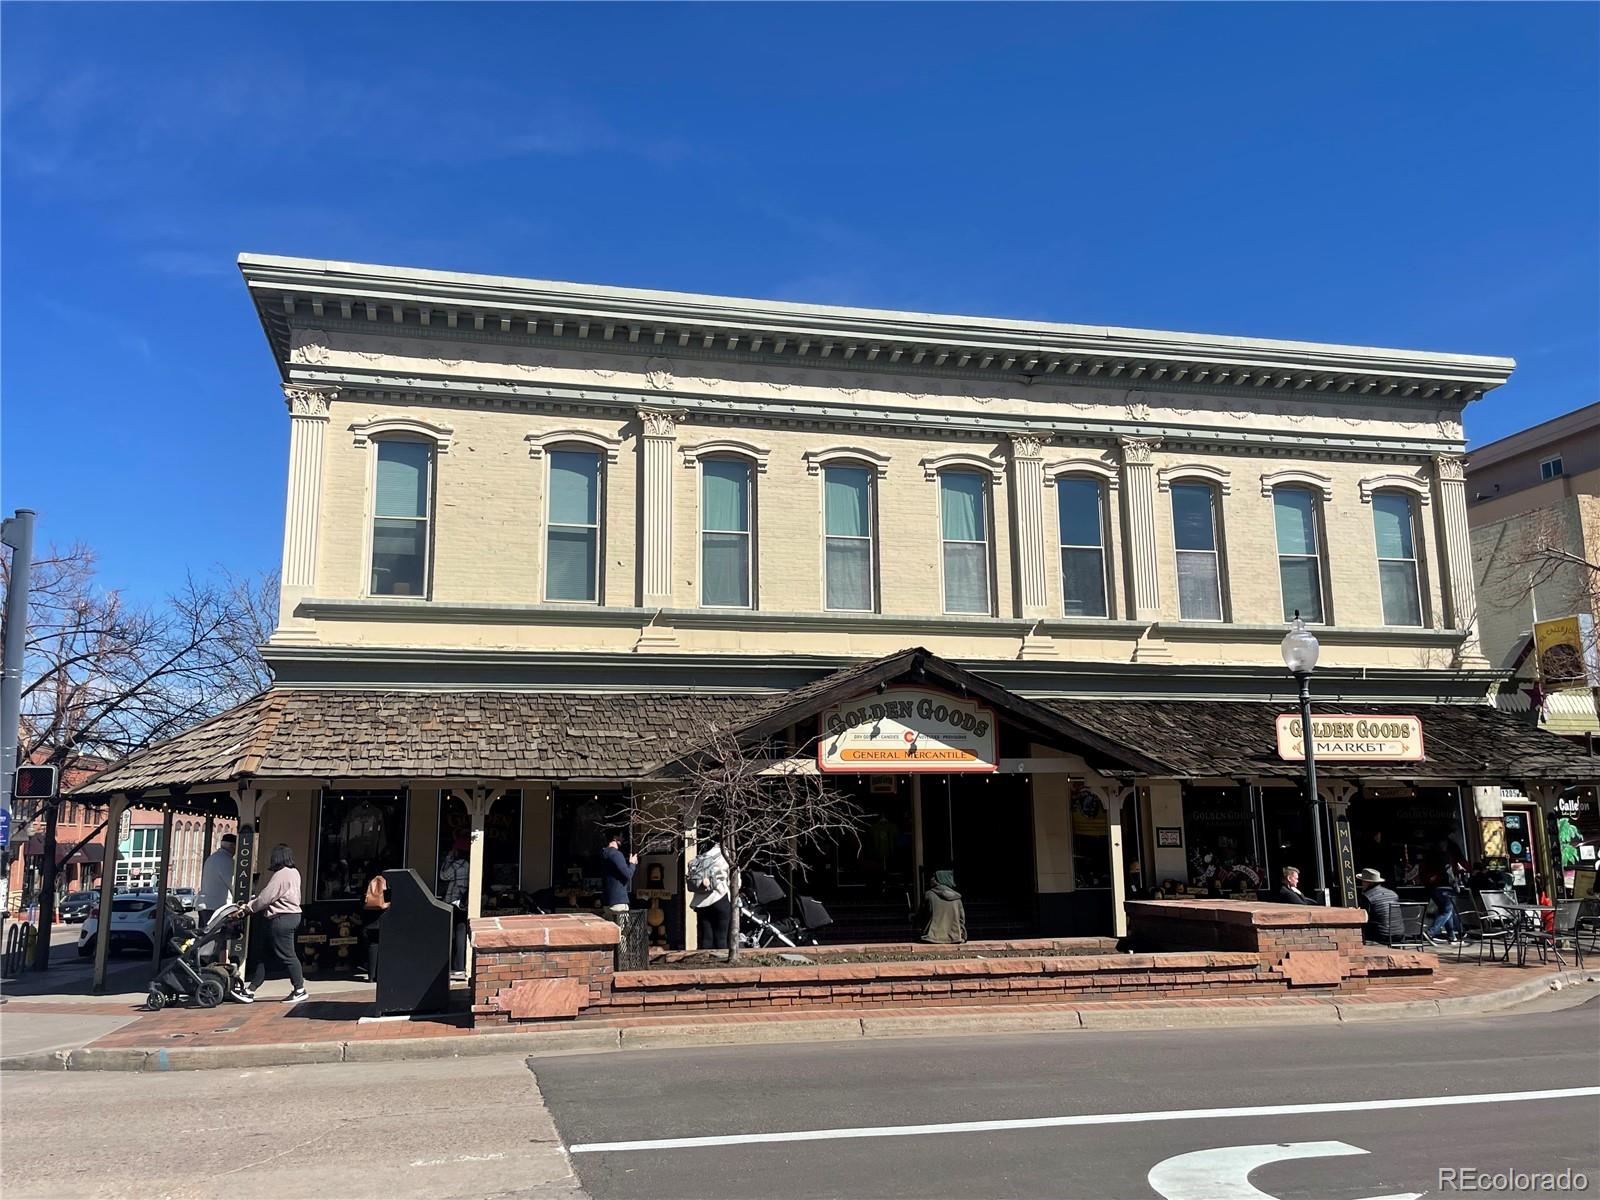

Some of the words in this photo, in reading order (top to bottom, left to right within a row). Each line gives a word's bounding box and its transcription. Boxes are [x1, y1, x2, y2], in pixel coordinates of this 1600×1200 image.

[827, 701, 912, 735] GOLDEN
[917, 698, 990, 738] GOODS
[1290, 719, 1354, 739] GLDEN
[1356, 719, 1411, 739] GOODS
[852, 751, 900, 759] GENERAL
[904, 750, 967, 759] MERCANTILE
[1317, 742, 1386, 753] MARKET
[239, 837, 249, 889] LOCAL
[1340, 829, 1355, 900] MARKE
